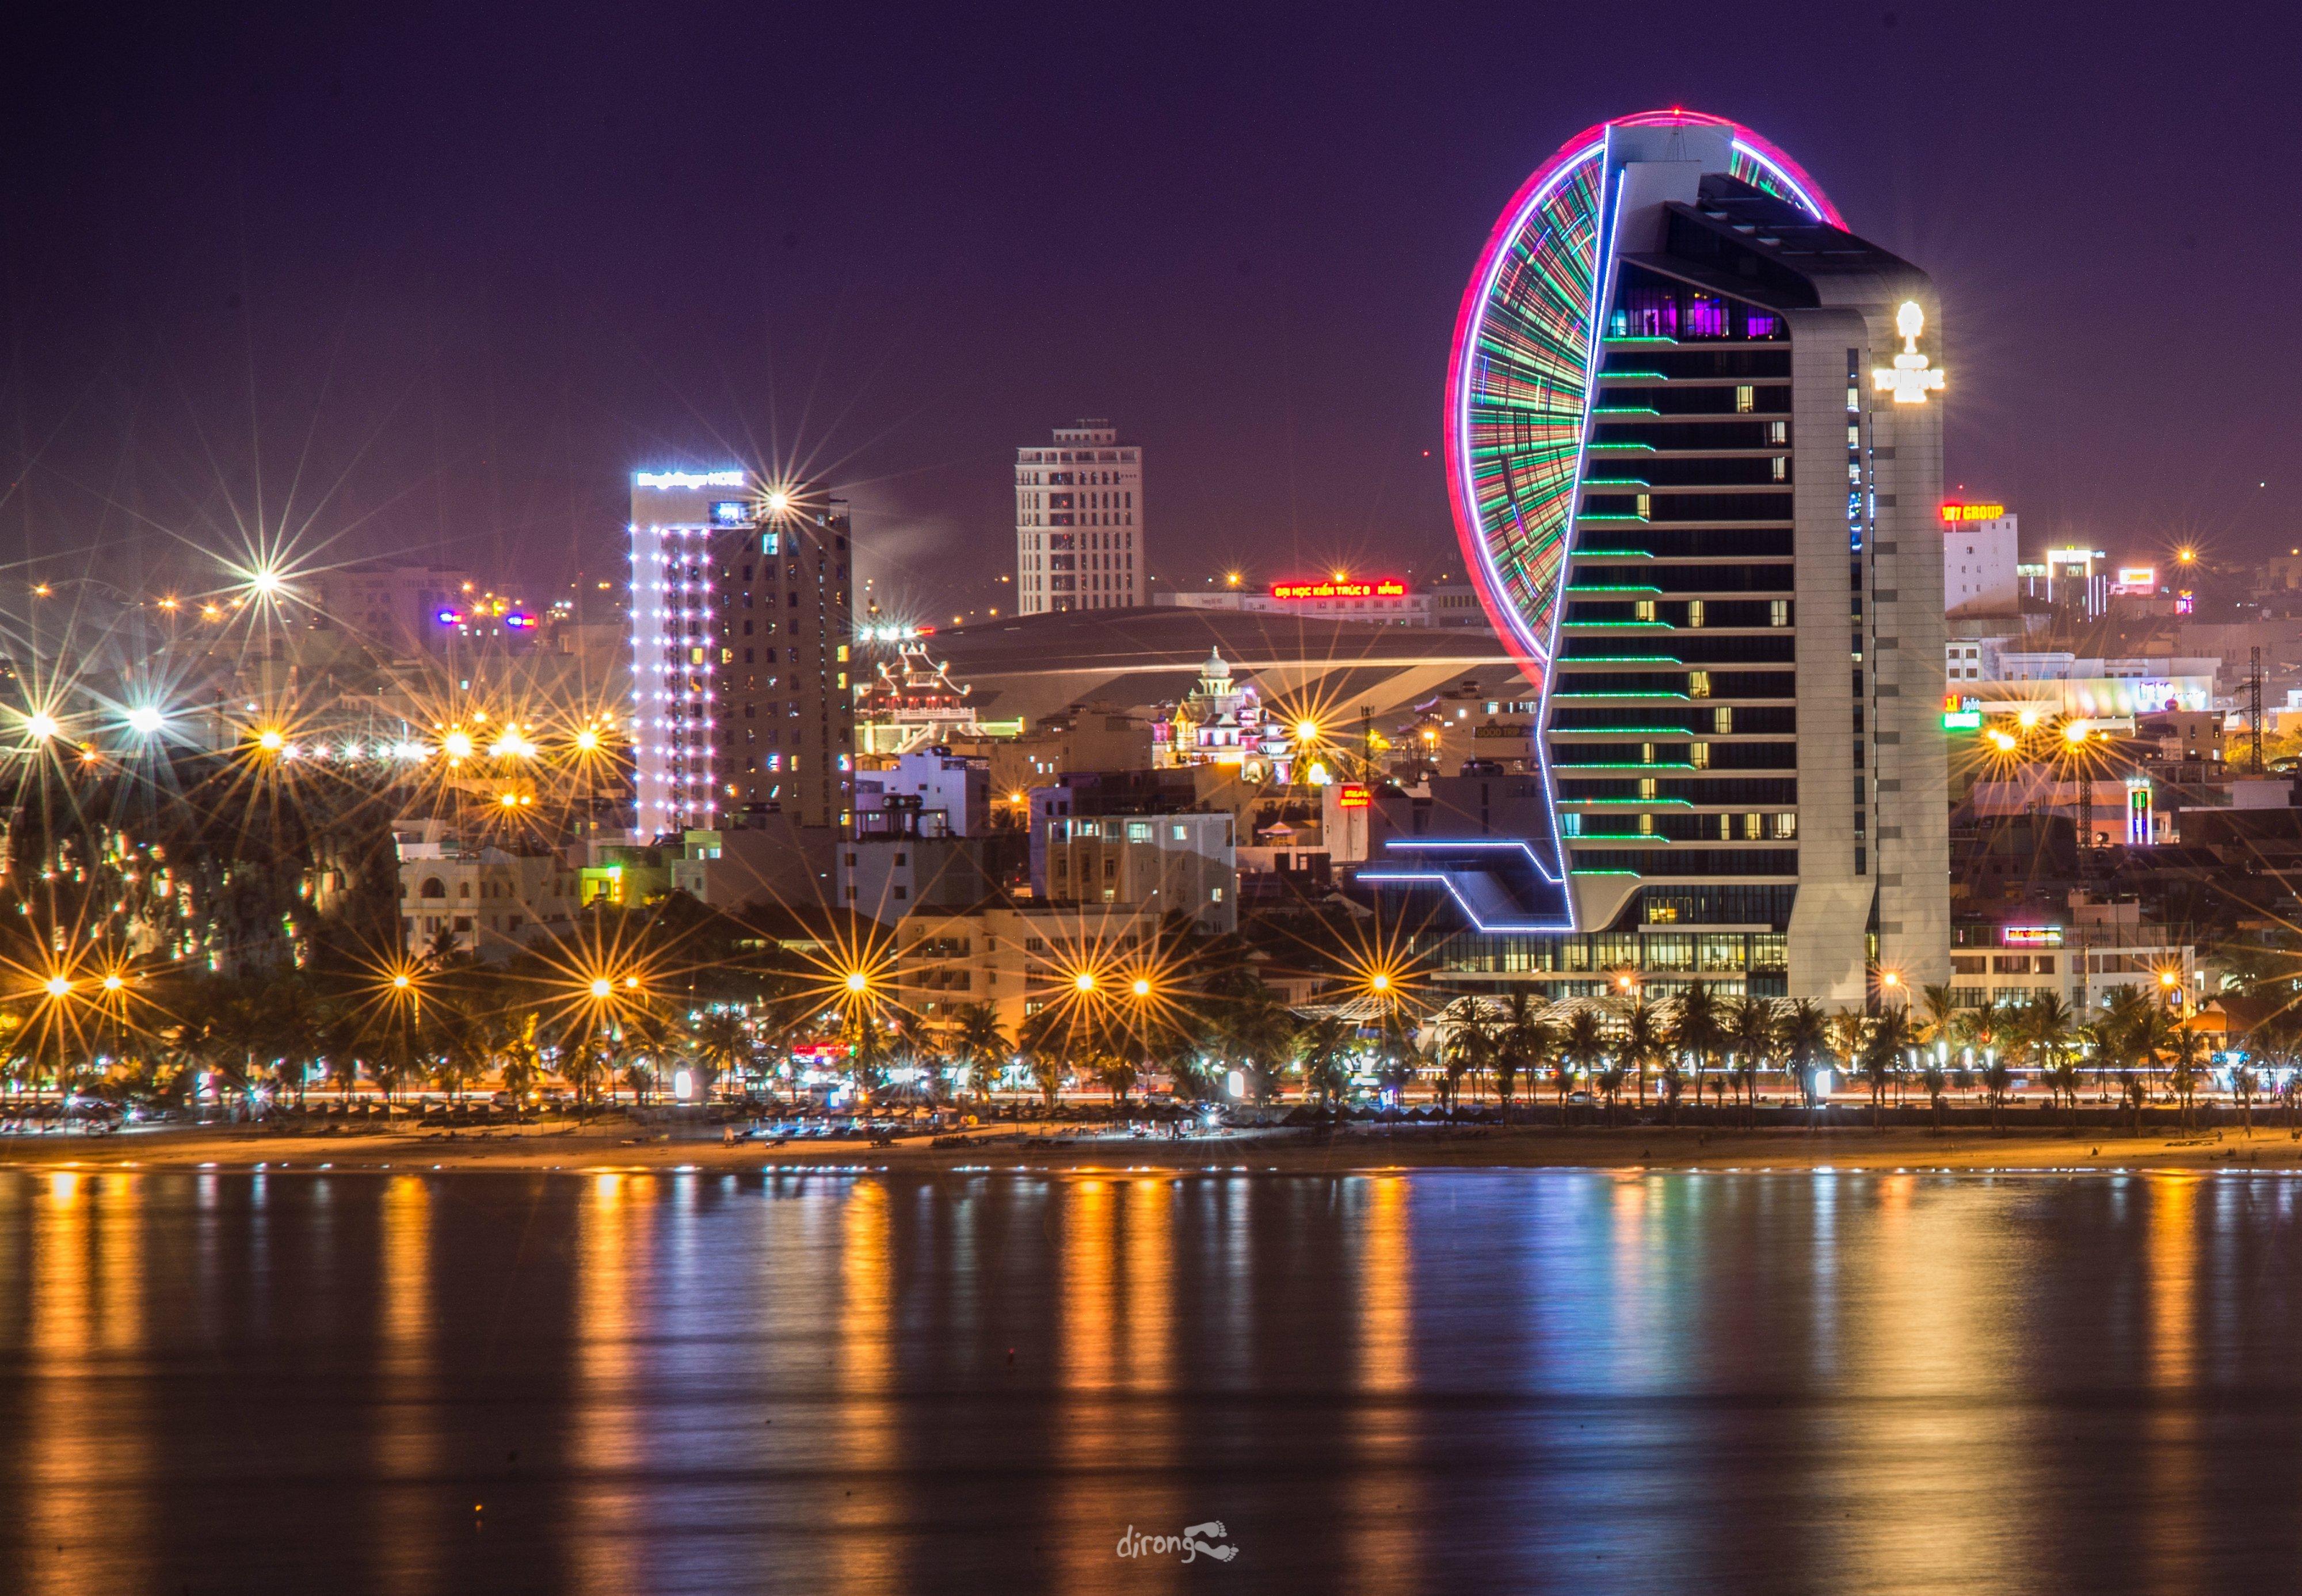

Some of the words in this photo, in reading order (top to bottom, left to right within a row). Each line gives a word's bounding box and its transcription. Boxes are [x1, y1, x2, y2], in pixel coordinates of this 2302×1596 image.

[1963, 506, 2003, 520] GROUP
[1292, 587, 1311, 599] HỌC
[1336, 585, 1362, 596] TRÚC
[1477, 727, 1501, 737] GOOD
[1504, 727, 1520, 737] TRIP
